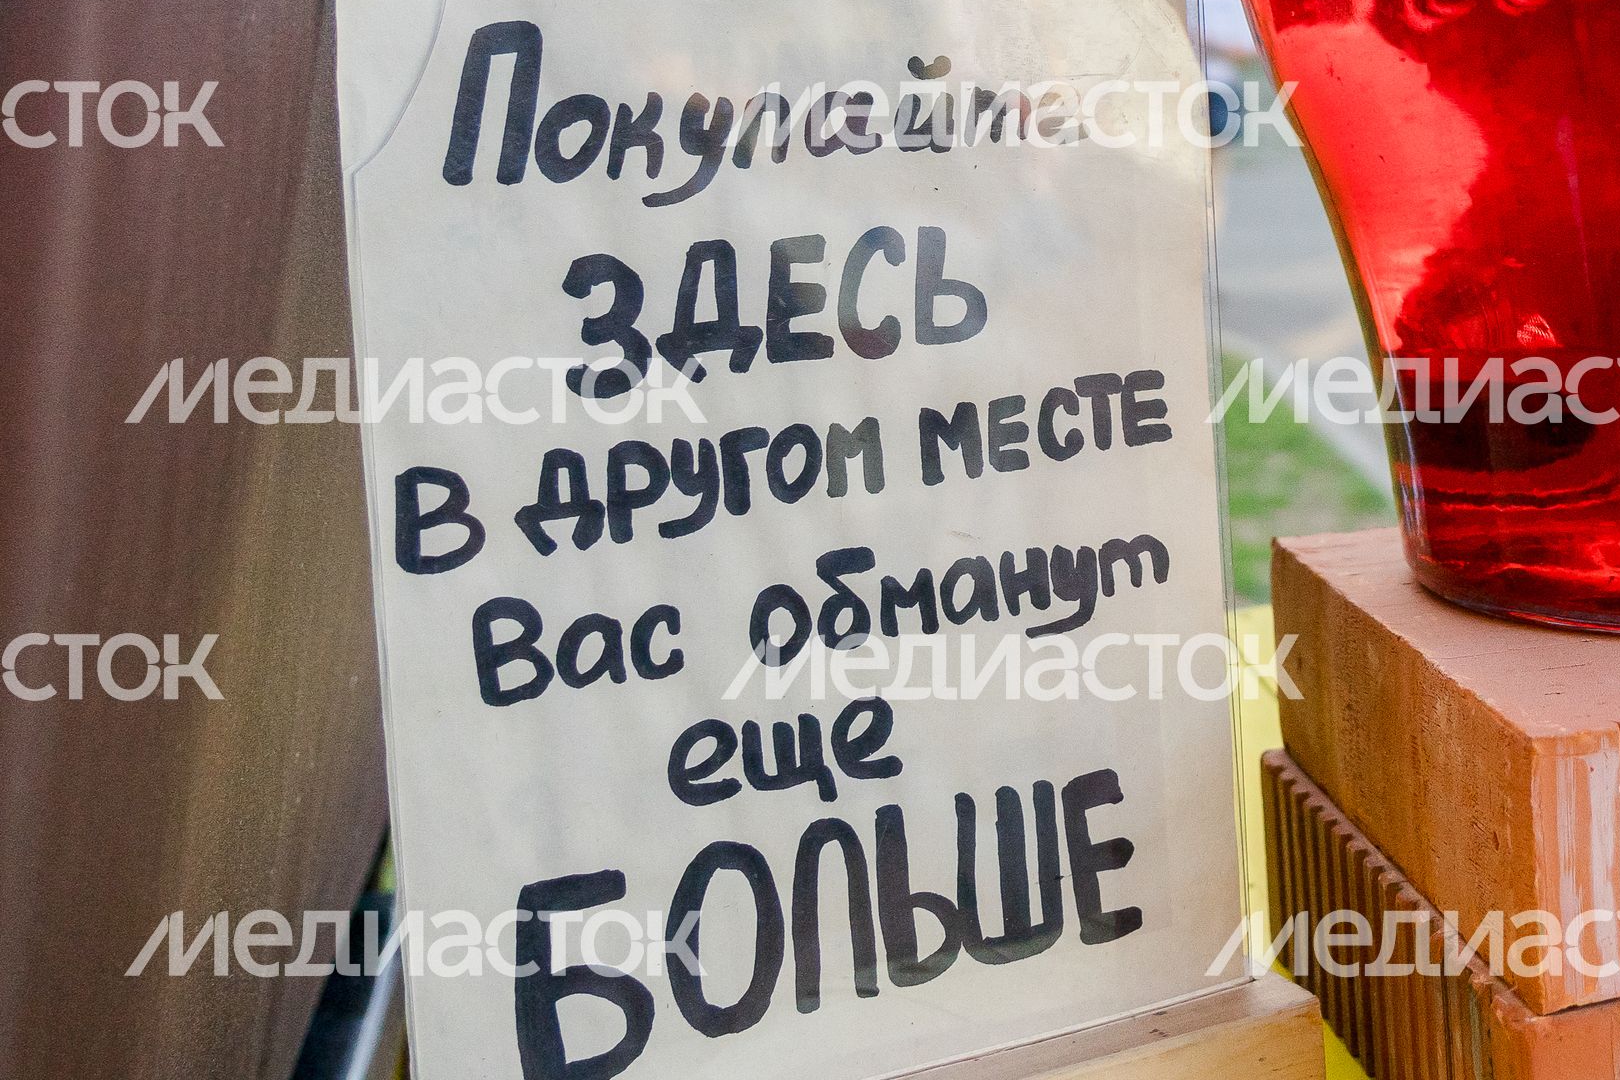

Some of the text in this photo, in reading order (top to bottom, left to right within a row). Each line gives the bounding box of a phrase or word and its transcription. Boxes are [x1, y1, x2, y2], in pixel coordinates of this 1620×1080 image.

[443, 20, 1089, 206] Покупайте
[562, 225, 988, 399] ЗДЕСЬ
[395, 369, 1173, 575] В ДРУГОМ МЕСТЕ
[472, 534, 1169, 706] Вас обманут
[667, 696, 904, 806] еще
[514, 768, 1143, 1080] БОЛЬШЕ
